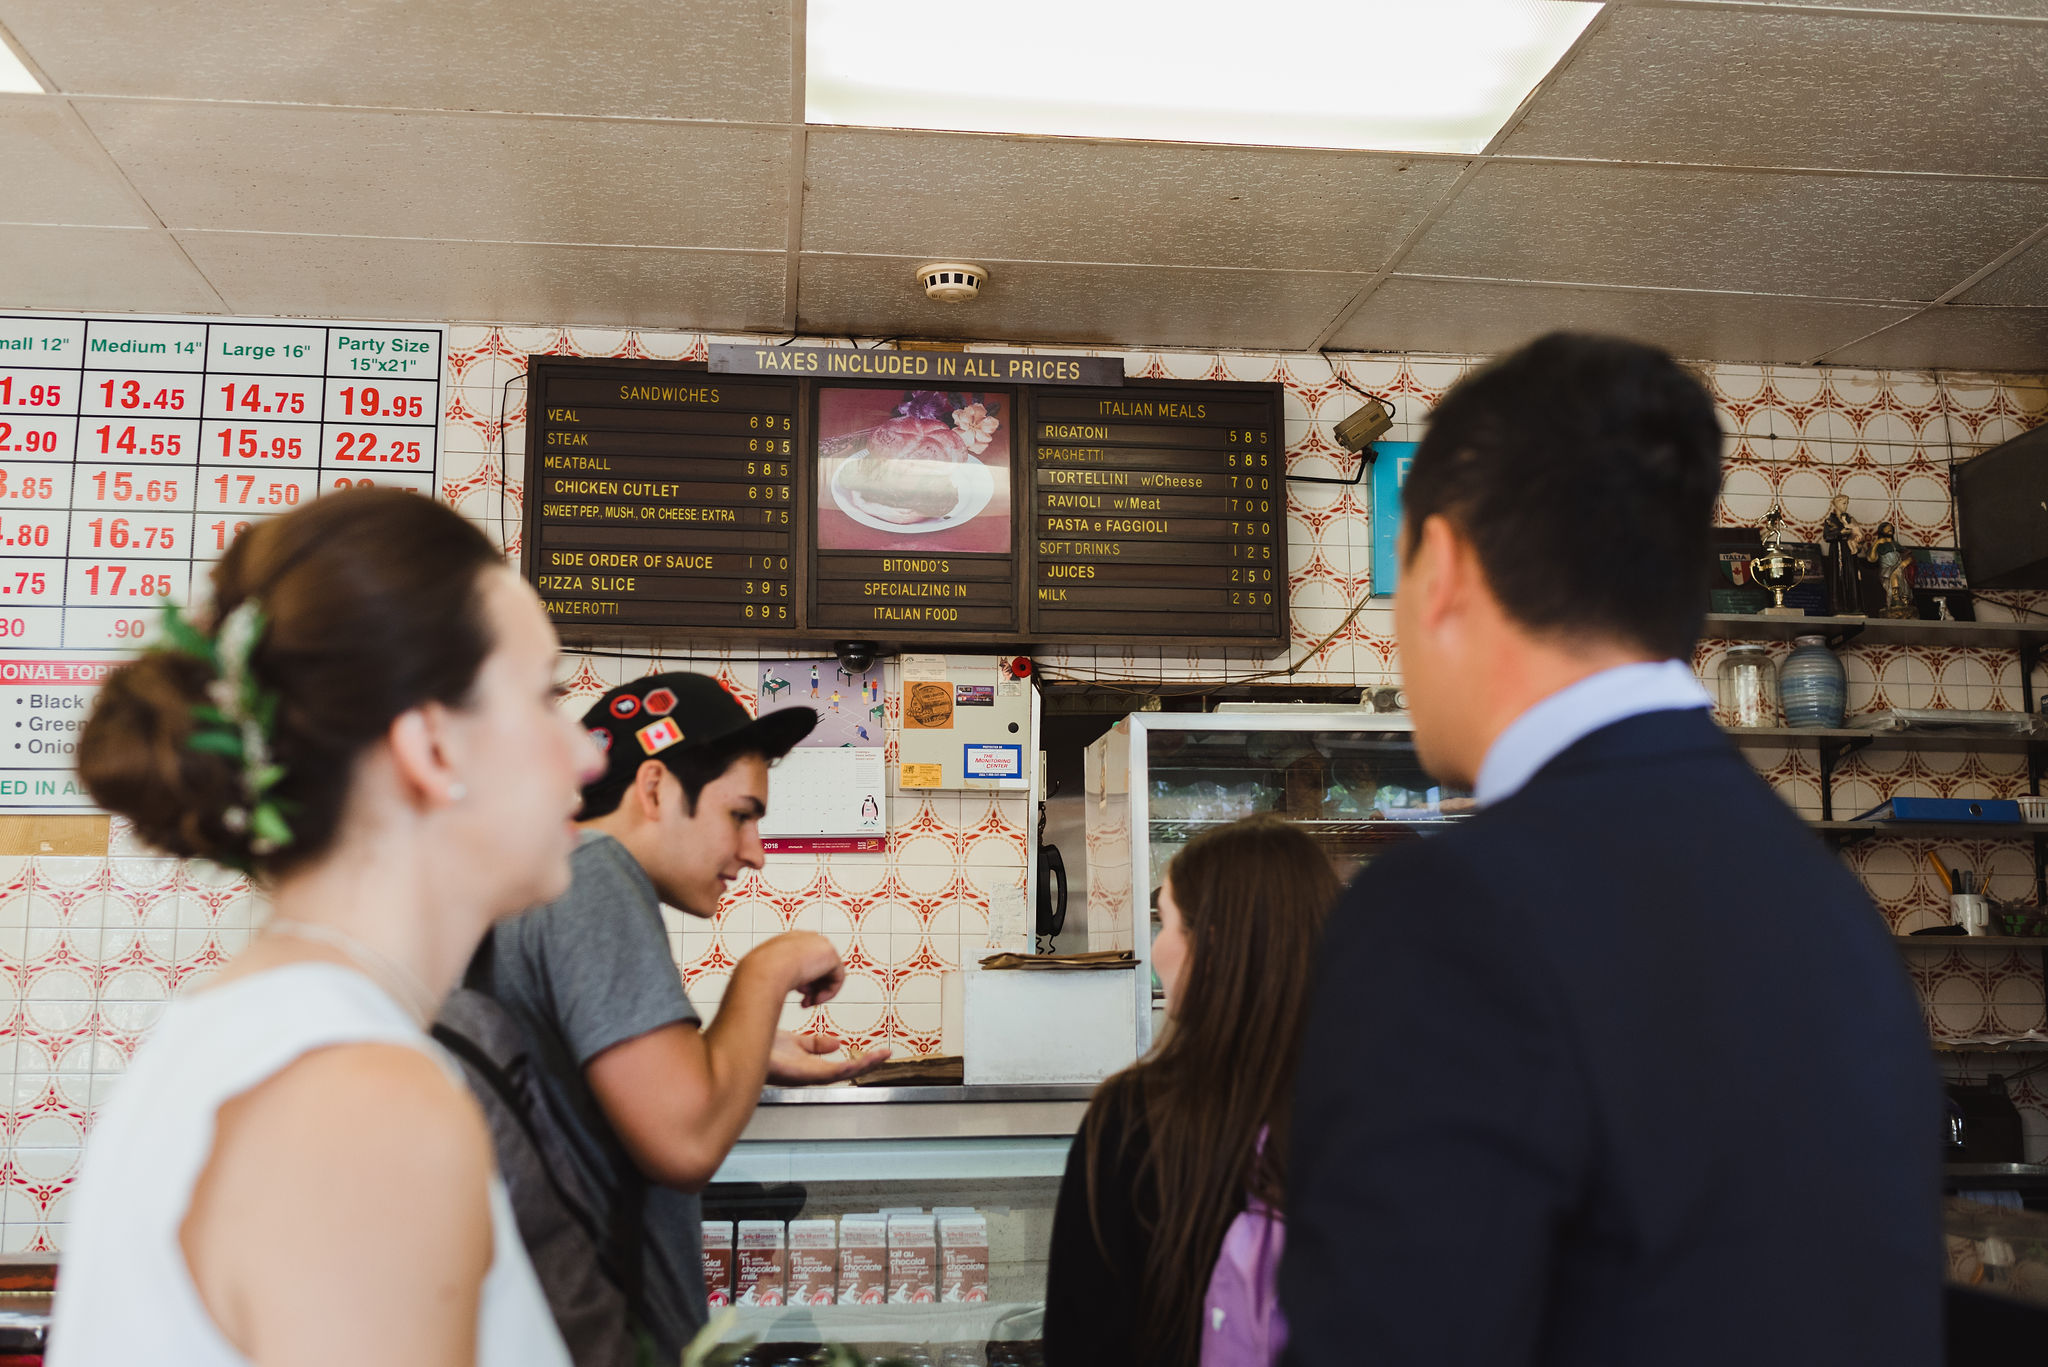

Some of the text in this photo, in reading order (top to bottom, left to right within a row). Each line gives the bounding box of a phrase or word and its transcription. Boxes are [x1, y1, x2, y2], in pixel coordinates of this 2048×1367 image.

[41, 338, 69, 351] 12"
[91, 339, 202, 354] Medium 14"
[223, 342, 311, 360] Large 16"
[338, 336, 430, 354] Party Size
[755, 351, 1080, 380] TAXES INCLUDED IN ALL PRICES
[100, 379, 185, 410] 13.45
[221, 383, 305, 414] 14.75
[619, 385, 720, 403] SANDWICHES
[340, 387, 423, 417] 19.95
[1100, 401, 1206, 418] ITALIAN MEALS
[548, 409, 580, 422] VEAL
[547, 433, 588, 446] STEAK
[1045, 426, 1108, 439] RIGATONI
[96, 425, 181, 456] 14.55
[218, 428, 302, 459] 15.95
[335, 432, 421, 463] 22.25
[1038, 448, 1104, 461] SPAGHETTI
[544, 457, 611, 471] MEATBALL
[92, 471, 177, 502] 15.65
[1049, 471, 1128, 485] TORTELLINI
[1141, 474, 1203, 488] w/Cheese
[214, 474, 300, 505] 17.50
[555, 480, 618, 495] CHICKEN
[623, 483, 679, 497] CUTLET
[1048, 495, 1101, 508] RAVIOLI
[1114, 497, 1161, 510] w/Meat
[543, 504, 579, 517] SWEET
[641, 507, 655, 520] OR
[701, 509, 735, 522] EXTRA
[88, 517, 174, 549] 16.75
[1048, 518, 1089, 531] PASTA
[1094, 523, 1102, 532] e
[1106, 520, 1168, 533] FAGGIOLI
[1039, 542, 1071, 554] SOFT
[1075, 543, 1120, 555] DRINKS
[551, 553, 584, 566] SIDE
[589, 554, 638, 568] ORDER
[644, 555, 662, 568] OF
[666, 555, 713, 569] SAUCE
[883, 559, 950, 572] BITONDO'S
[1048, 565, 1095, 578] JUICES
[85, 565, 171, 597] 17.85
[538, 576, 583, 590] PIZZA
[591, 577, 635, 591] SLICE
[864, 583, 967, 597] SPECIALIZING IN
[1038, 588, 1067, 601] MILK
[536, 601, 619, 615] PANZEROTTI
[874, 607, 958, 620] ITALIAN FOOD
[30, 694, 84, 708] Black
[36, 781, 55, 795] IN
